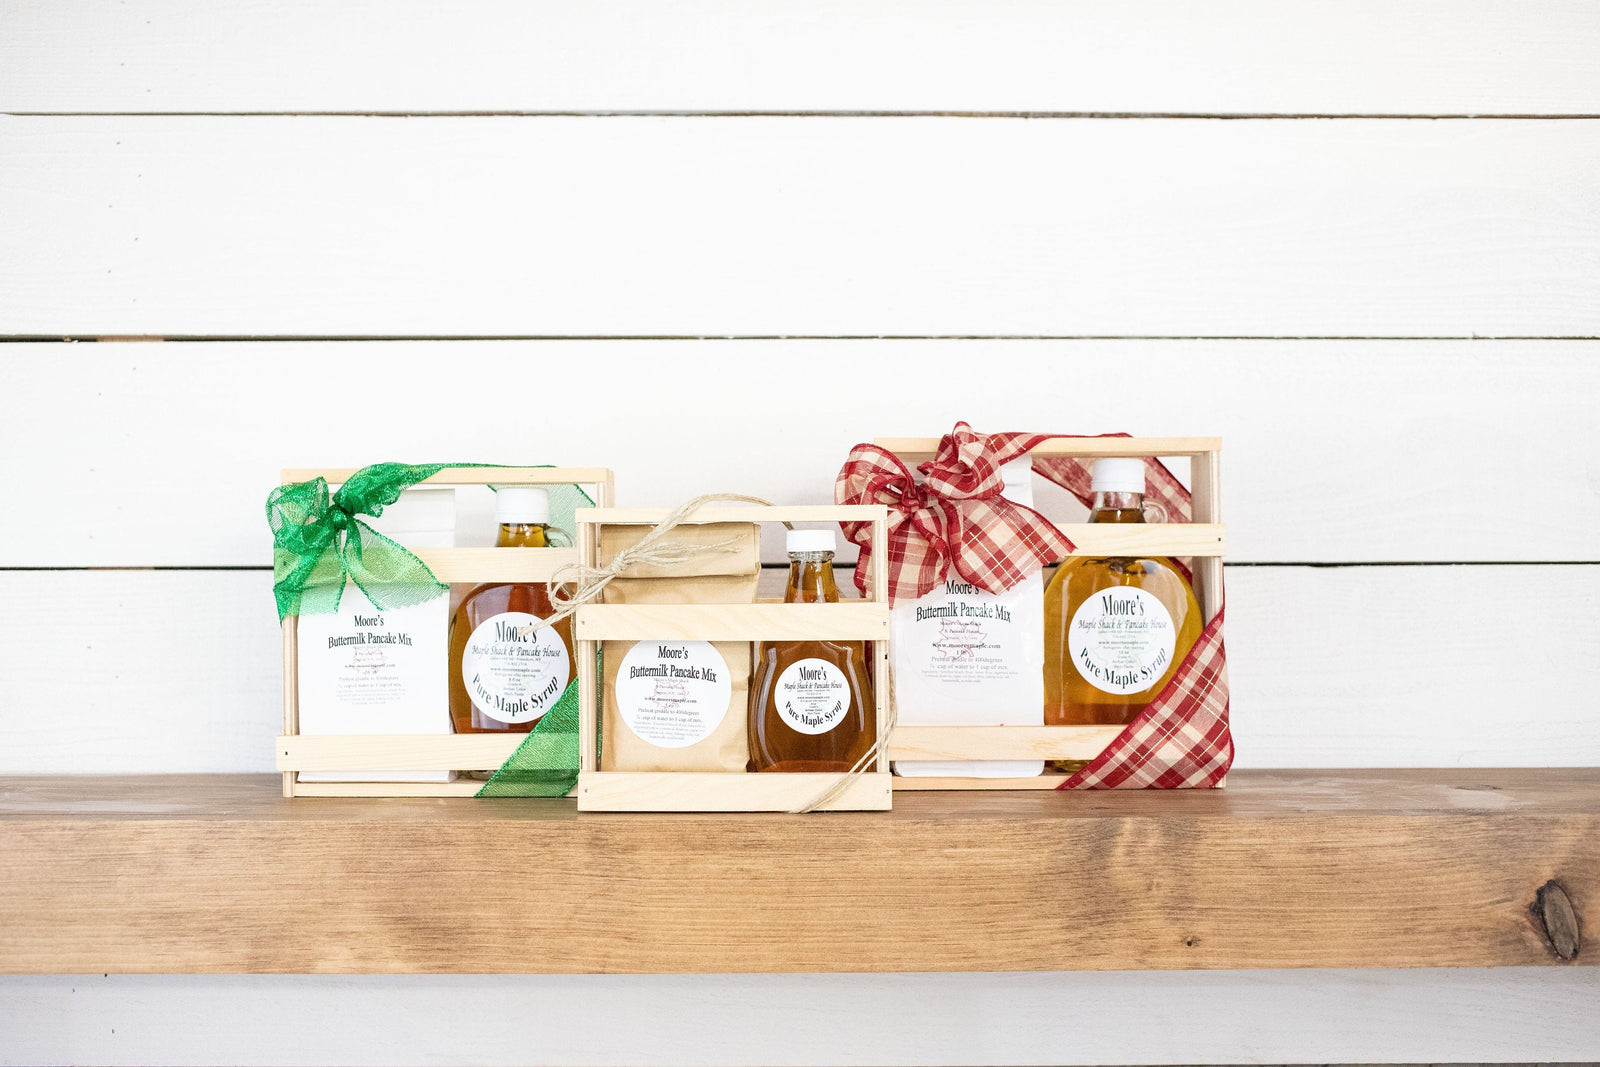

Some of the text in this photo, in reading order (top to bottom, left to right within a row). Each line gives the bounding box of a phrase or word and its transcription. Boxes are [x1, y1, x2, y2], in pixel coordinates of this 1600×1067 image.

[946, 580, 979, 594] Moores
[917, 602, 1010, 622] Buttermilk Pancake Mix
[1103, 595, 1144, 616] Moore's
[354, 615, 384, 627] Moore's
[1079, 617, 1167, 633] Maple Shack & Pancake House
[328, 632, 412, 648] Buttermilk Pancake Mix
[472, 644, 560, 658] Maple Shack & Pancake House
[658, 646, 688, 659] Moore's
[630, 664, 716, 682] Buttermilk Pancake Mix
[800, 666, 826, 681] Moore's
[1081, 647, 1166, 689] Pure Maple Syrup
[473, 673, 558, 716] Pure Maple Syrup
[784, 682, 796, 692] Maple
[797, 681, 808, 689] Shack
[786, 700, 841, 728] Pure Maple Syrup
